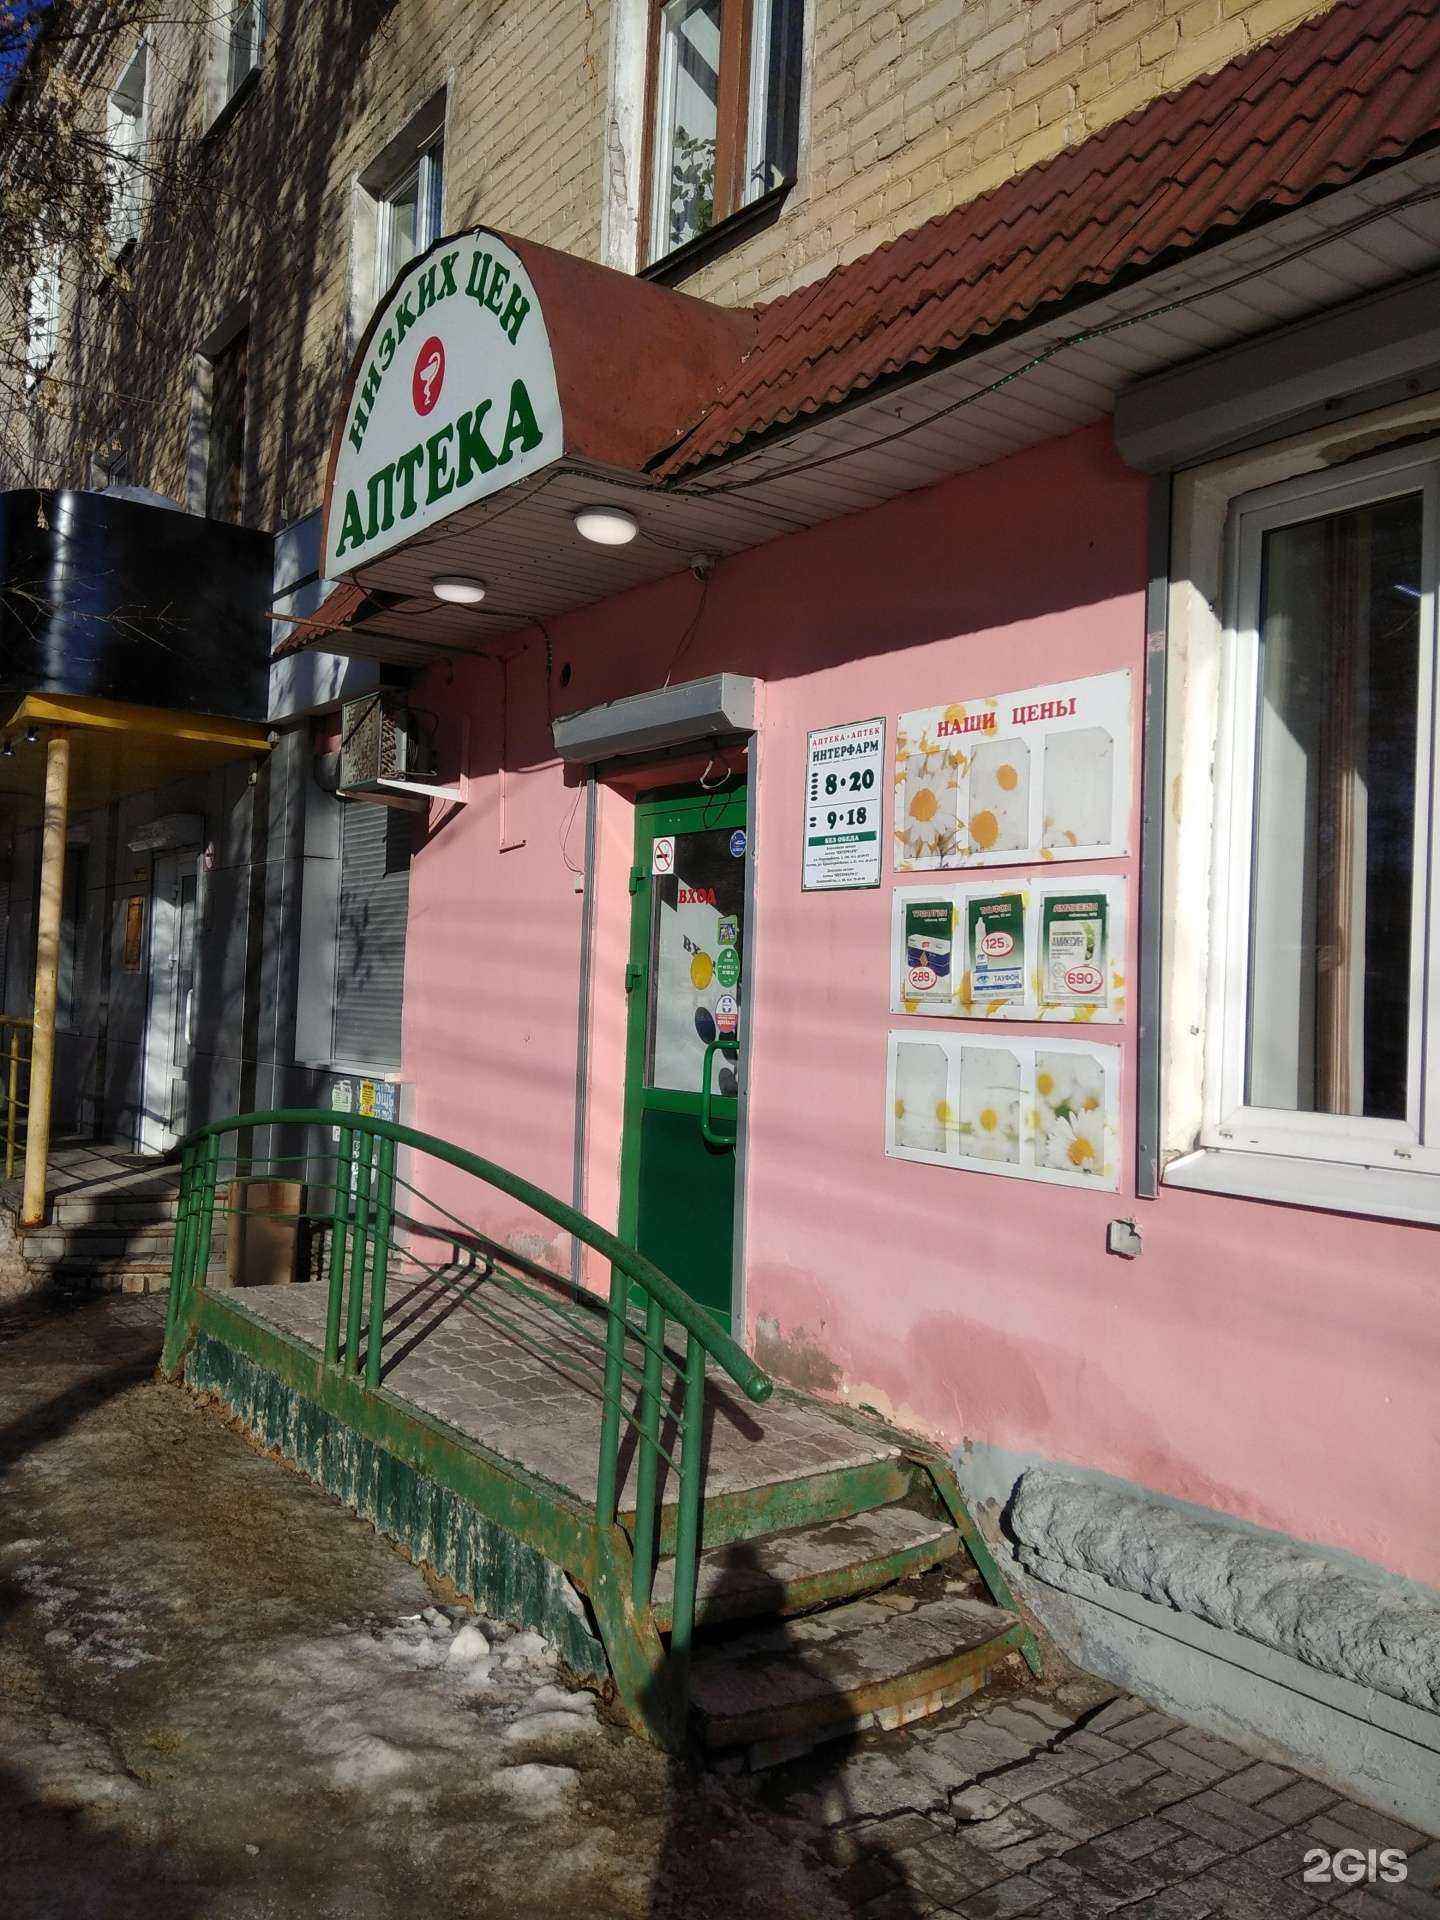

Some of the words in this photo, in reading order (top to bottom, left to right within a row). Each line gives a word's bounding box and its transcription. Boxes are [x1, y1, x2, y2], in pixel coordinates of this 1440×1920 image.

[349, 251, 460, 455] НИЗКИХ
[465, 250, 531, 346] ЦЕН
[335, 378, 544, 558] АПТЕКА
[937, 711, 996, 738] НАШИ
[1011, 697, 1077, 725] ЦЕНЫ
